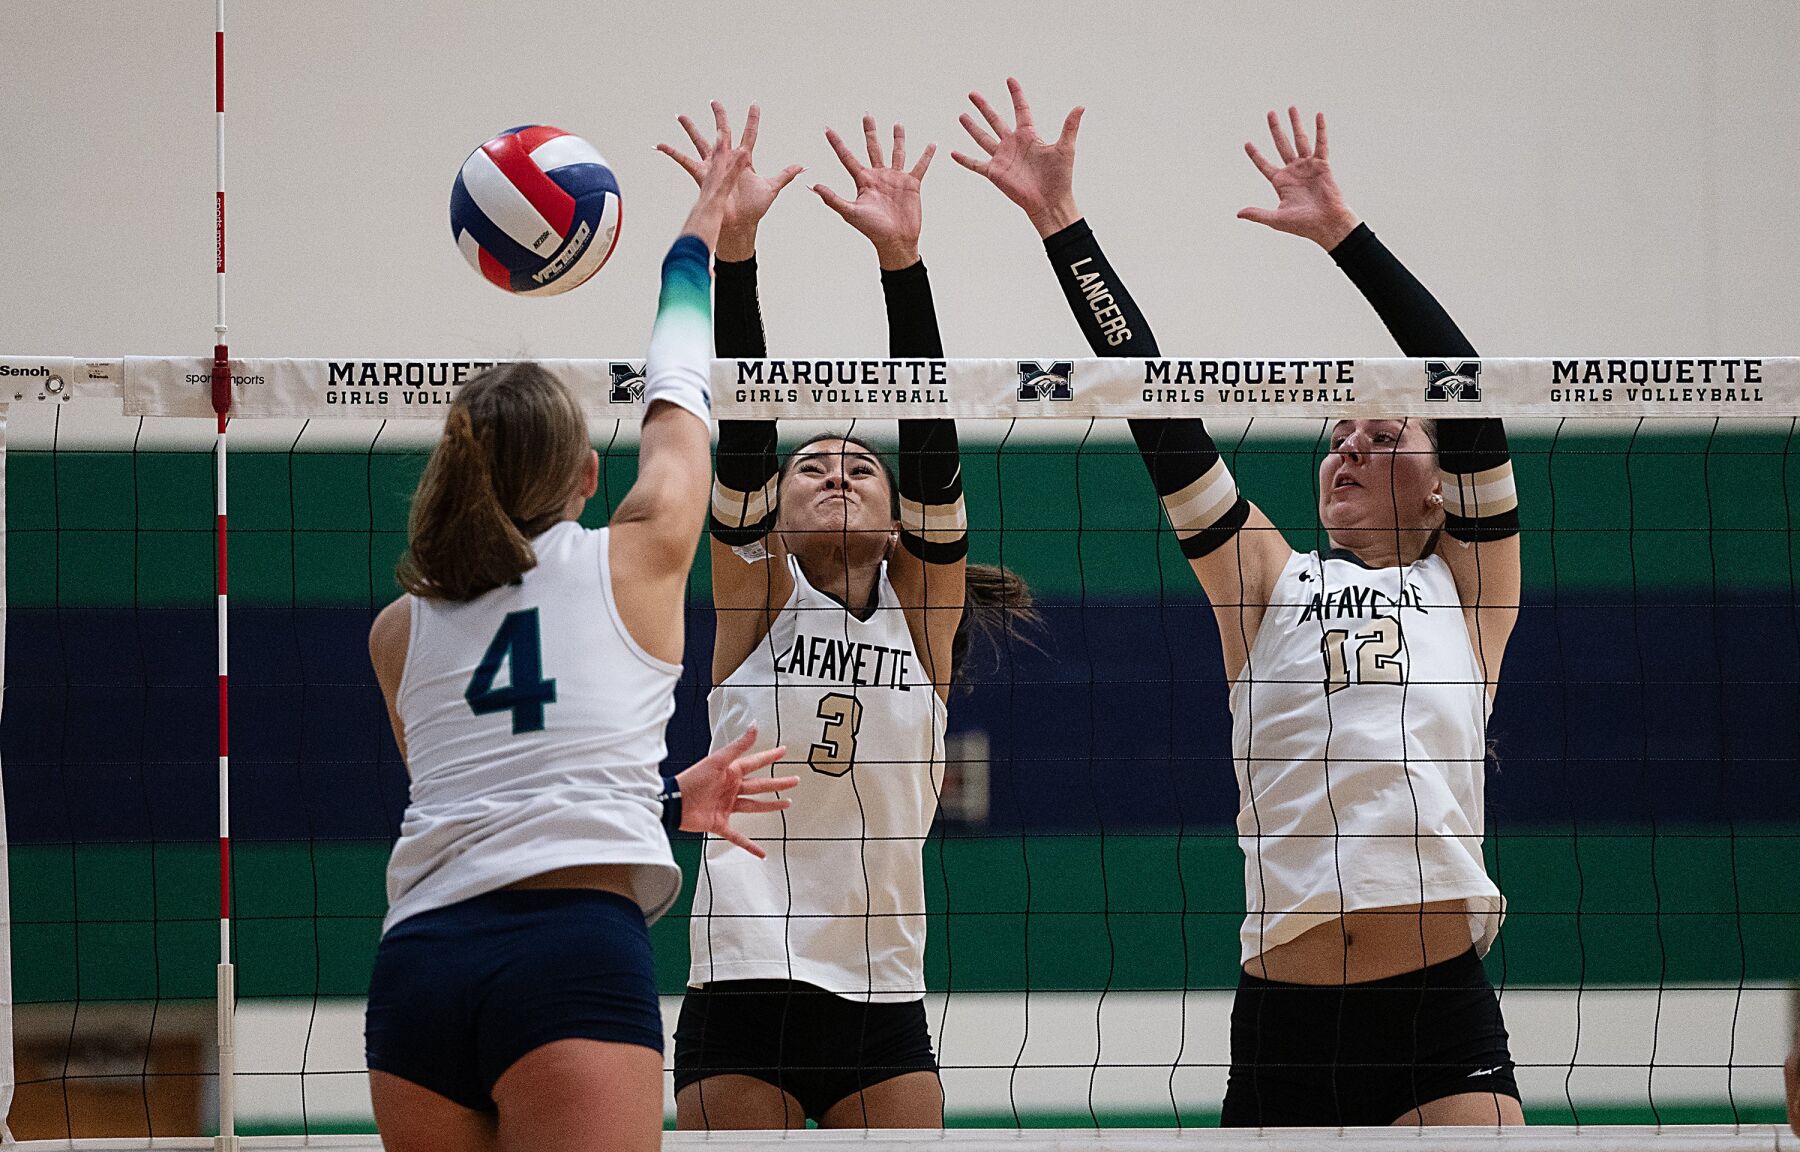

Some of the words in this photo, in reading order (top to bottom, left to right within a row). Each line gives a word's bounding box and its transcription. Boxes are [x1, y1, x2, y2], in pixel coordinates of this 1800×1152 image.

[1069, 256, 1133, 347] LANCERS
[0, 365, 50, 377] Senoh
[185, 374, 212, 385] spor
[231, 375, 265, 387] ports
[328, 362, 538, 389] MARQUE
[737, 360, 947, 388] MARQUETTE
[1144, 360, 1354, 388] MARQUETTE
[1552, 359, 1762, 387] MARQUETTE
[326, 390, 389, 405] GIRLS
[735, 389, 798, 403] GIRLS
[811, 389, 948, 403] VOLLEYBALL
[1142, 389, 1204, 403] GIRLS
[1218, 388, 1356, 403] VOLLEYBALL
[1550, 388, 1613, 403] GIRLS
[1626, 388, 1764, 402] VOLLEYBALL
[774, 634, 911, 692] LAFAYETTE
[1320, 615, 1404, 697] 12
[464, 606, 557, 735] 4
[807, 692, 864, 777] 3
